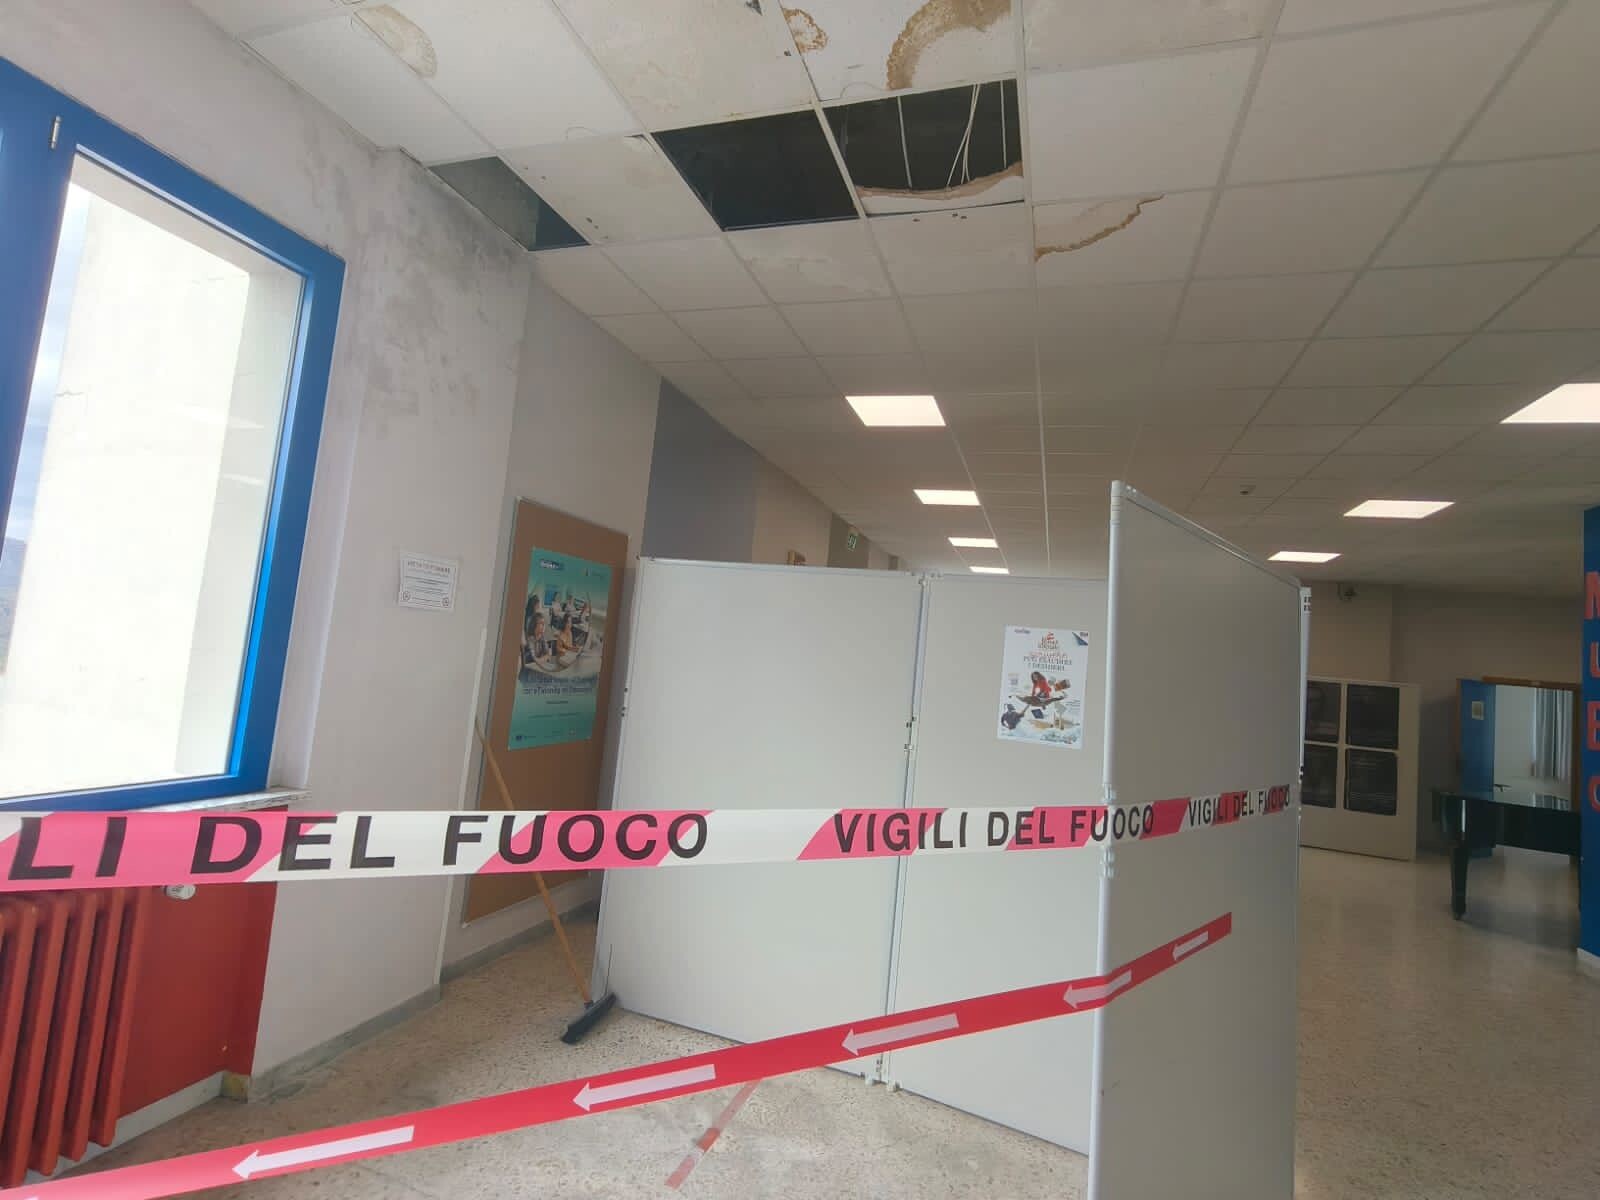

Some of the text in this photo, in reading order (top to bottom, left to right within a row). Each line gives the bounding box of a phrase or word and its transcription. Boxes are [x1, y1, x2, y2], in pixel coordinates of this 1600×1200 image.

[834, 805, 1154, 853] VIGILI DEL FUOCO
[1188, 796, 1228, 827] VIGILI
[1233, 791, 1254, 817] DEL
[190, 815, 396, 874] DEL
[442, 812, 708, 867] FUOCO
